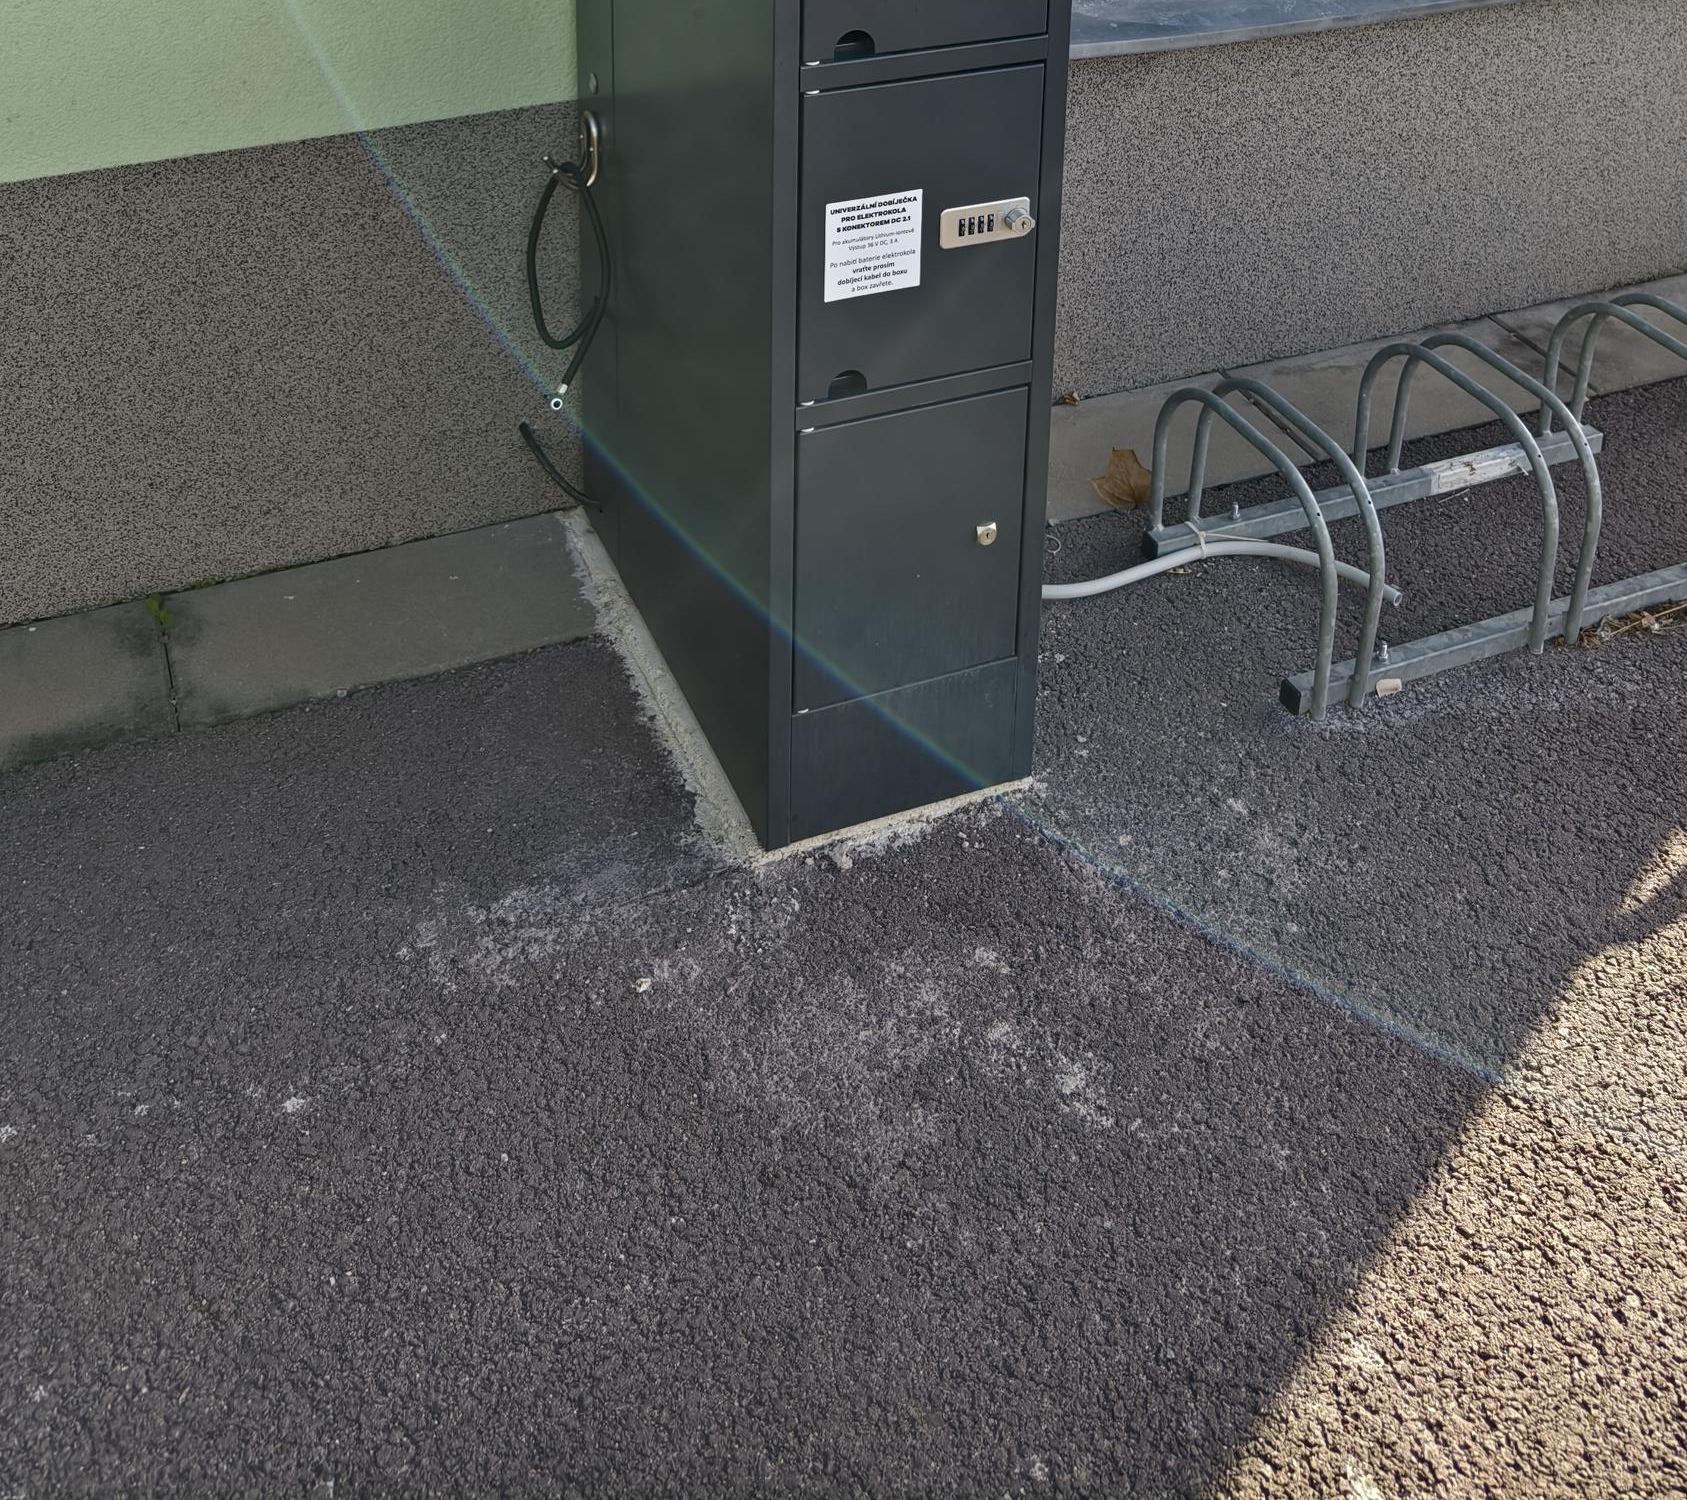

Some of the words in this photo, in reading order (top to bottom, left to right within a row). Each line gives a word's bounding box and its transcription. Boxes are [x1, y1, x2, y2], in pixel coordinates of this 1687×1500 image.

[830, 201, 877, 215] UNIVERZÁLNÍ
[878, 196, 917, 207] DOBÍJEČKA
[841, 215, 856, 223] PRO
[857, 207, 906, 220] ELEKTROKOLA
[842, 219, 890, 232] KONEKTOREM
[858, 255, 880, 264] baterie
[882, 249, 916, 259] elektrokola
[853, 266, 872, 274] vraťte
[873, 262, 895, 271] prosím
[837, 275, 863, 285] dobíjecí
[864, 272, 881, 280] kabel
